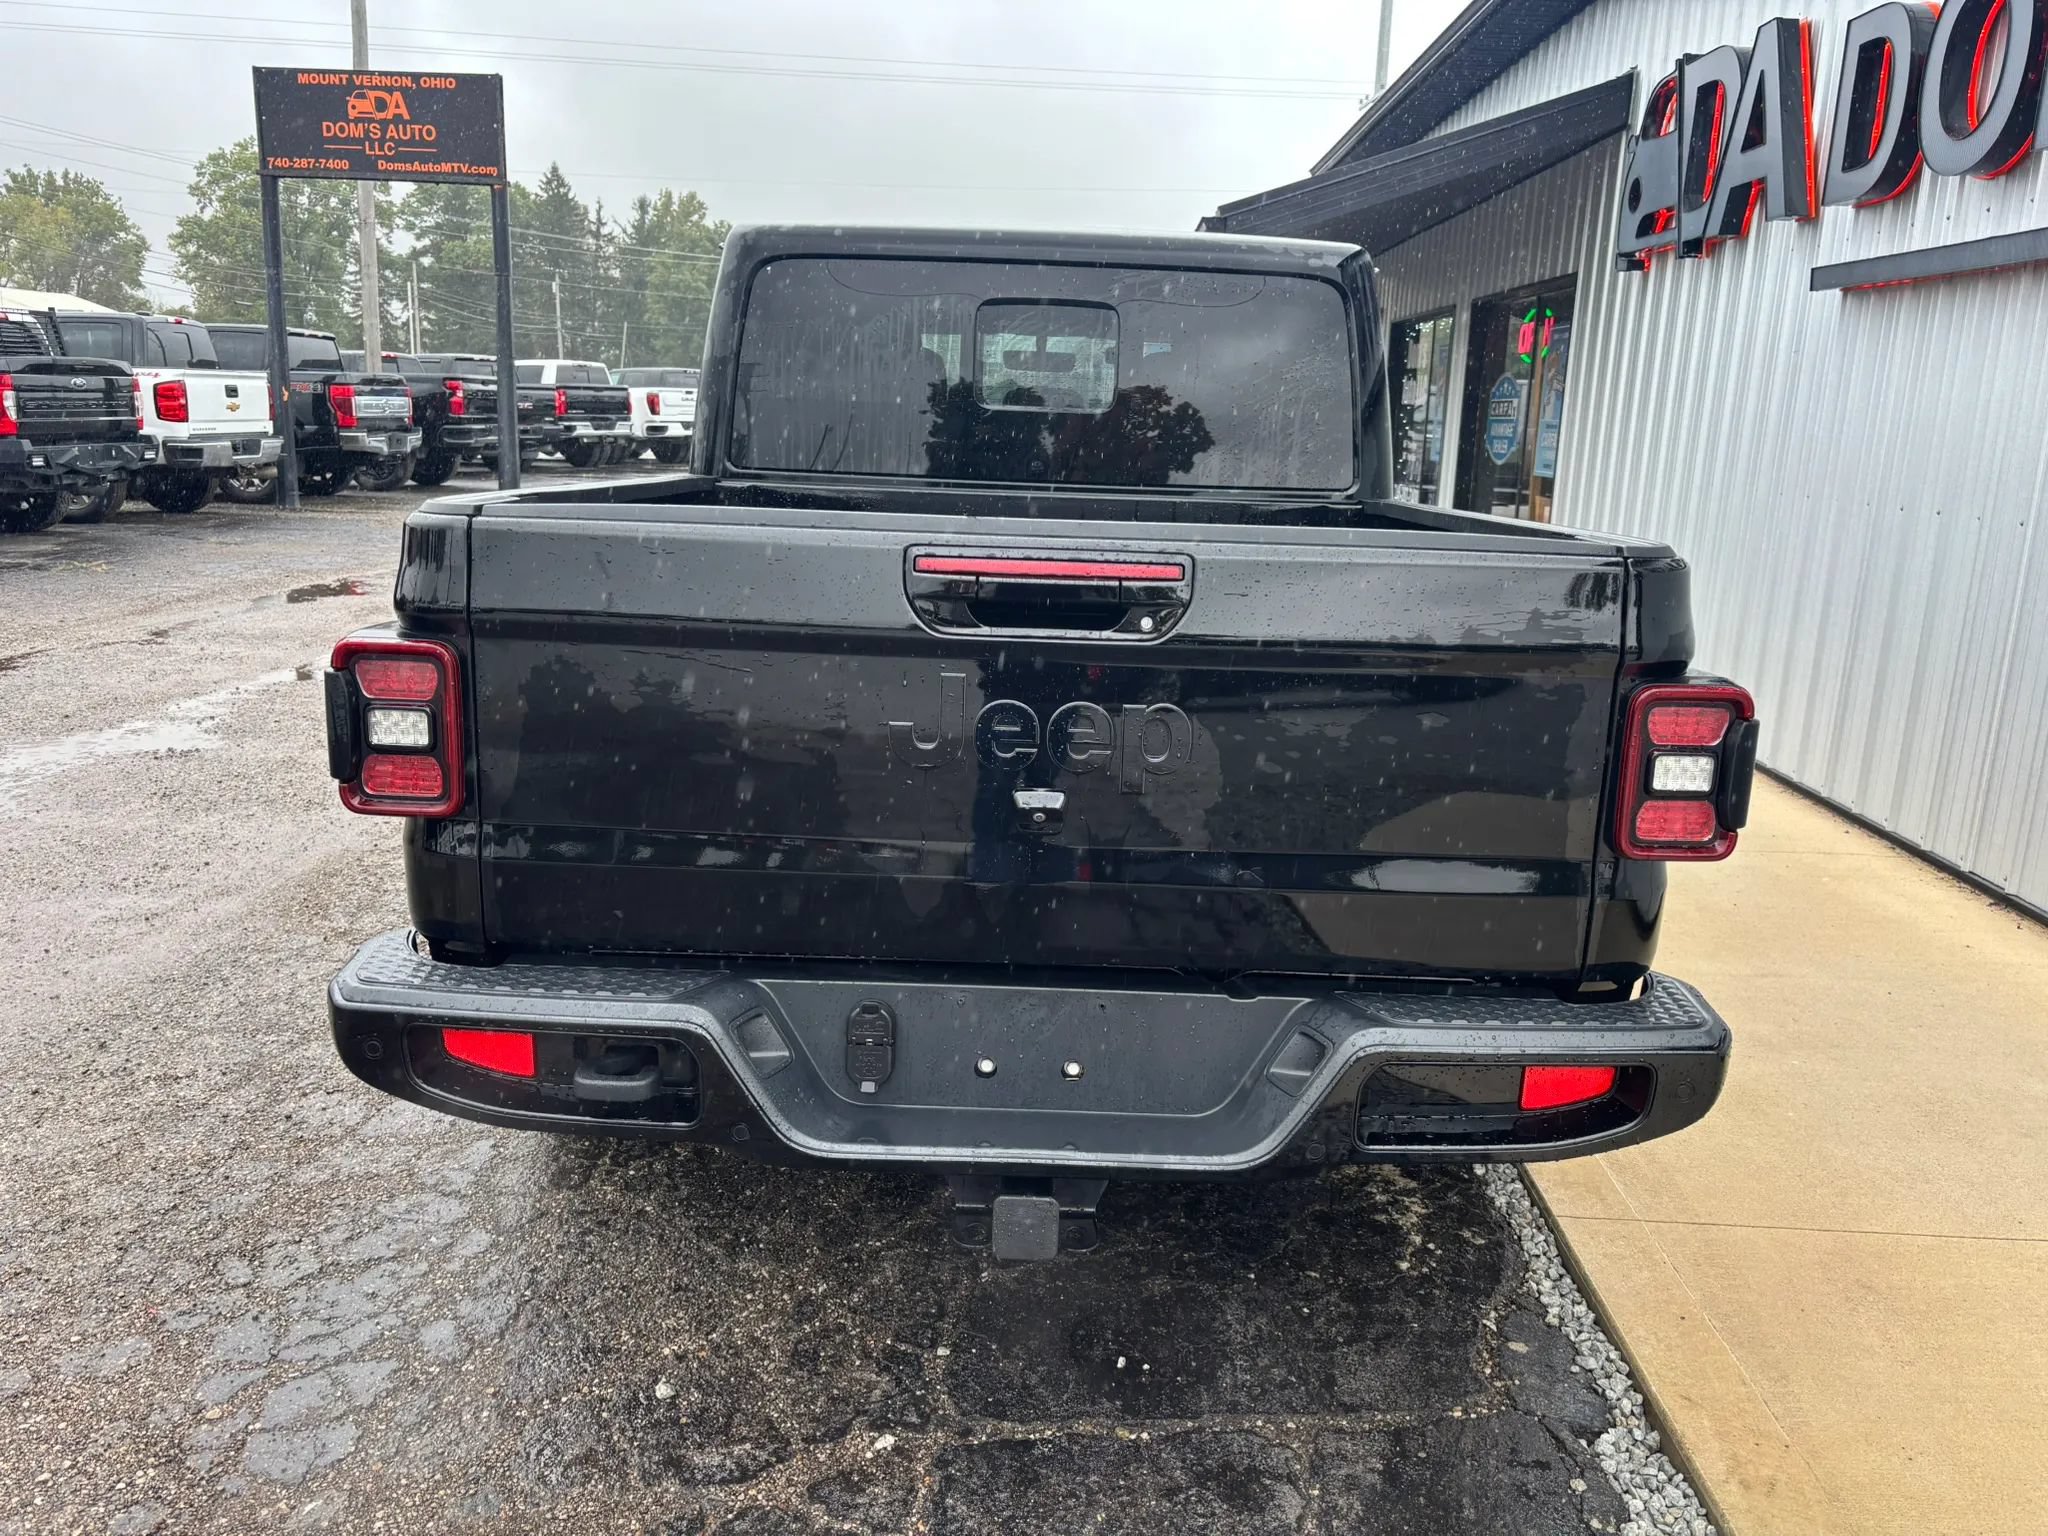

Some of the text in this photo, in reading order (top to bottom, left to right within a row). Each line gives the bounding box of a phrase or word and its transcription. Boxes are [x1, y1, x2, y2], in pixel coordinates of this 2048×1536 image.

[297, 73, 457, 90] MOUNT VERNON, OHIO
[367, 90, 411, 120] DA
[322, 121, 437, 141] DOM'S AUTO
[365, 142, 396, 156] LLC
[267, 157, 349, 170] 740-287-7400
[377, 159, 498, 176] DomsAutoMTV.com
[888, 672, 1194, 794] Jeep
